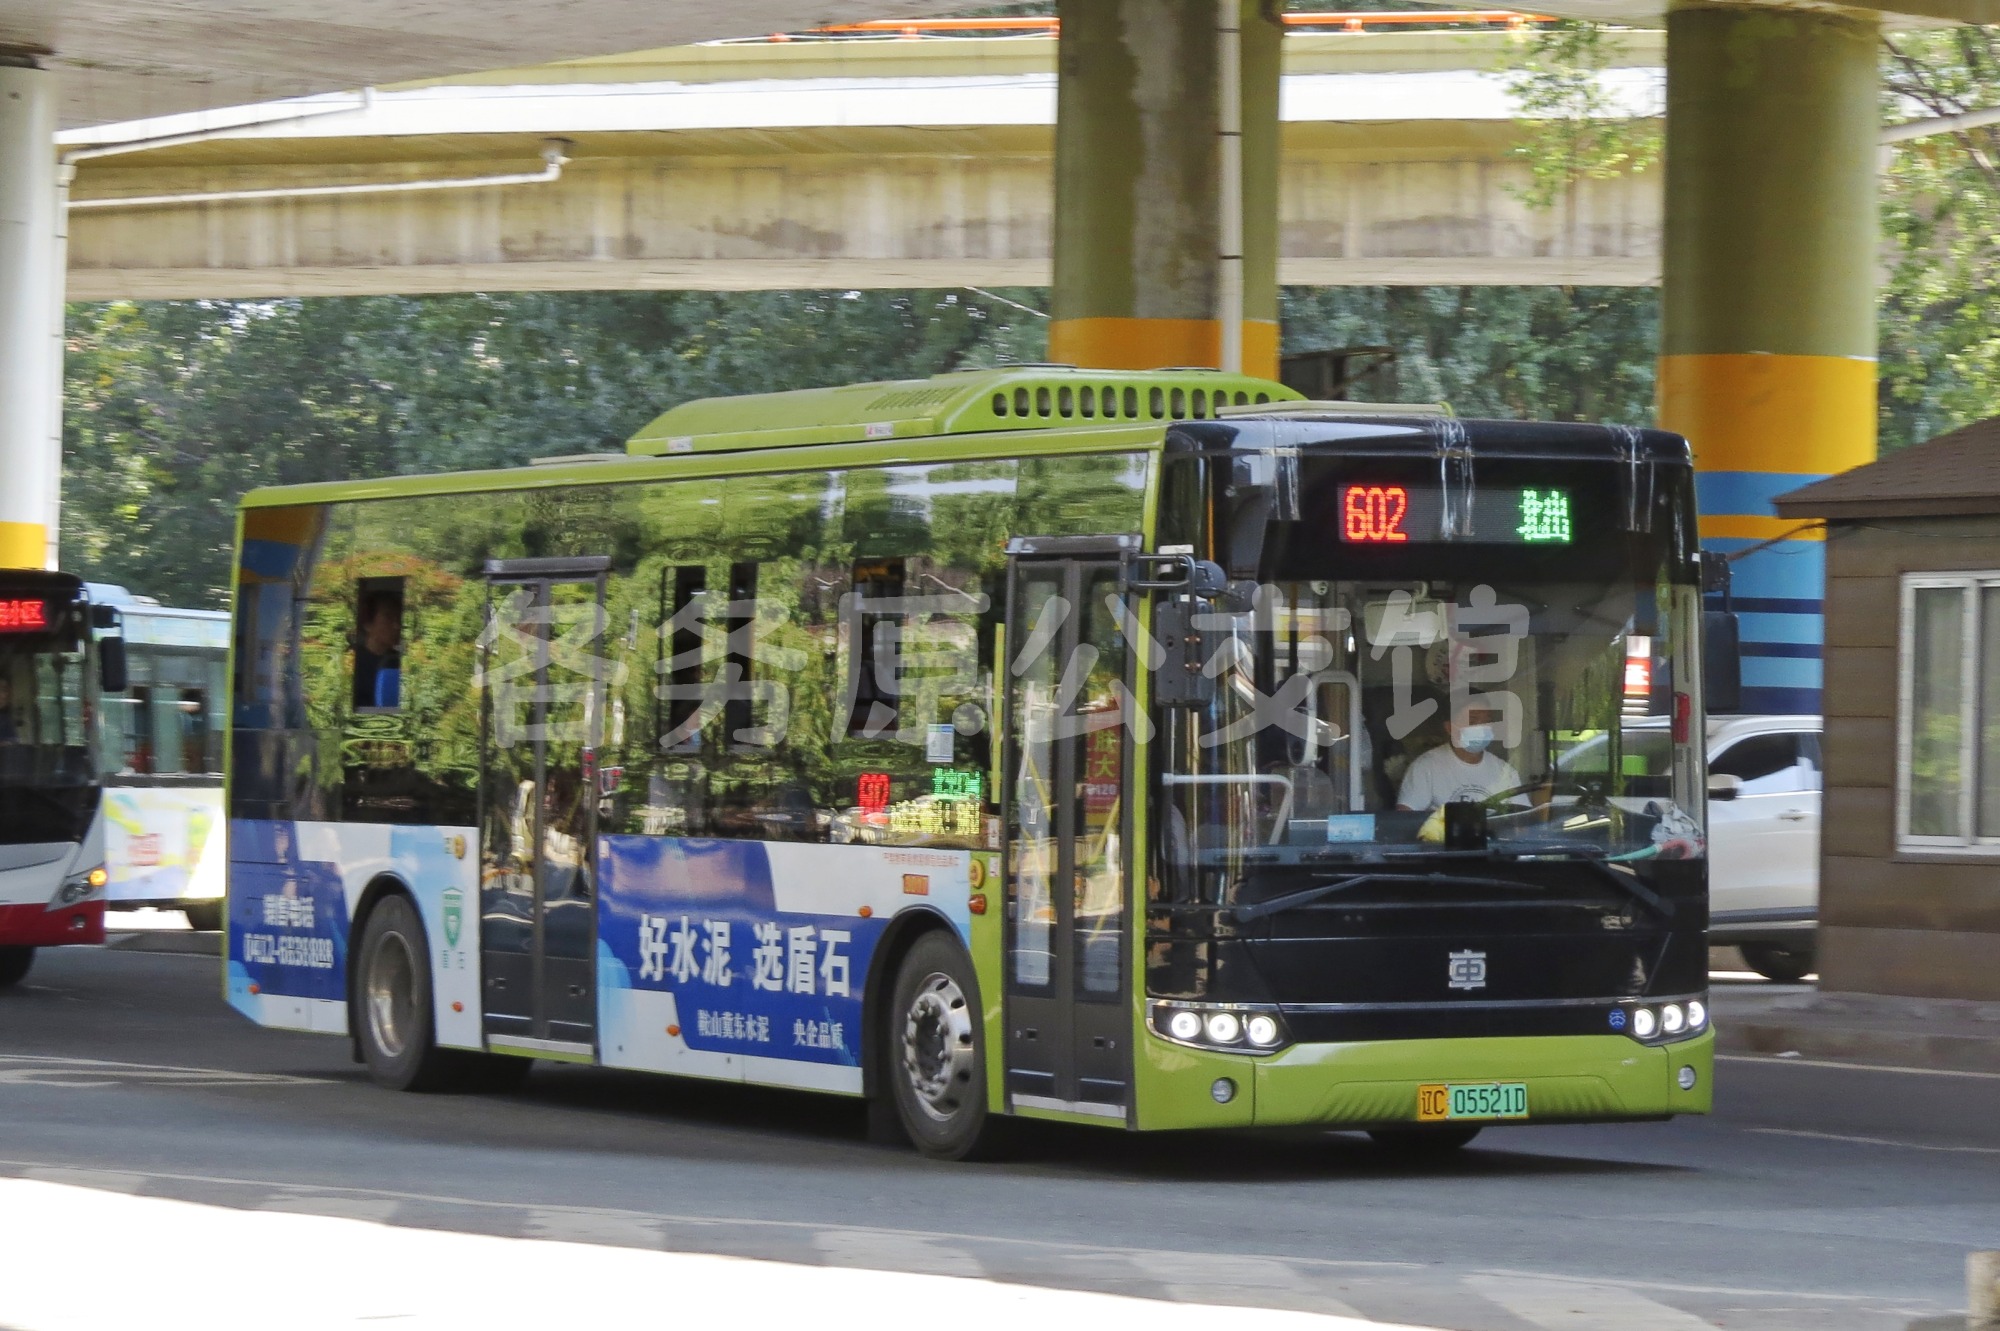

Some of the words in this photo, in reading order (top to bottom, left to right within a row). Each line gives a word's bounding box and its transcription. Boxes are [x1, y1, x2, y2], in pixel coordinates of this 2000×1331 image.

[1346, 486, 1408, 541] 602
[639, 913, 733, 988] 好水泥
[752, 920, 852, 998] 选盾石
[697, 1008, 771, 1043] 鞍山冀东水泥
[792, 1017, 845, 1050] 央企品质
